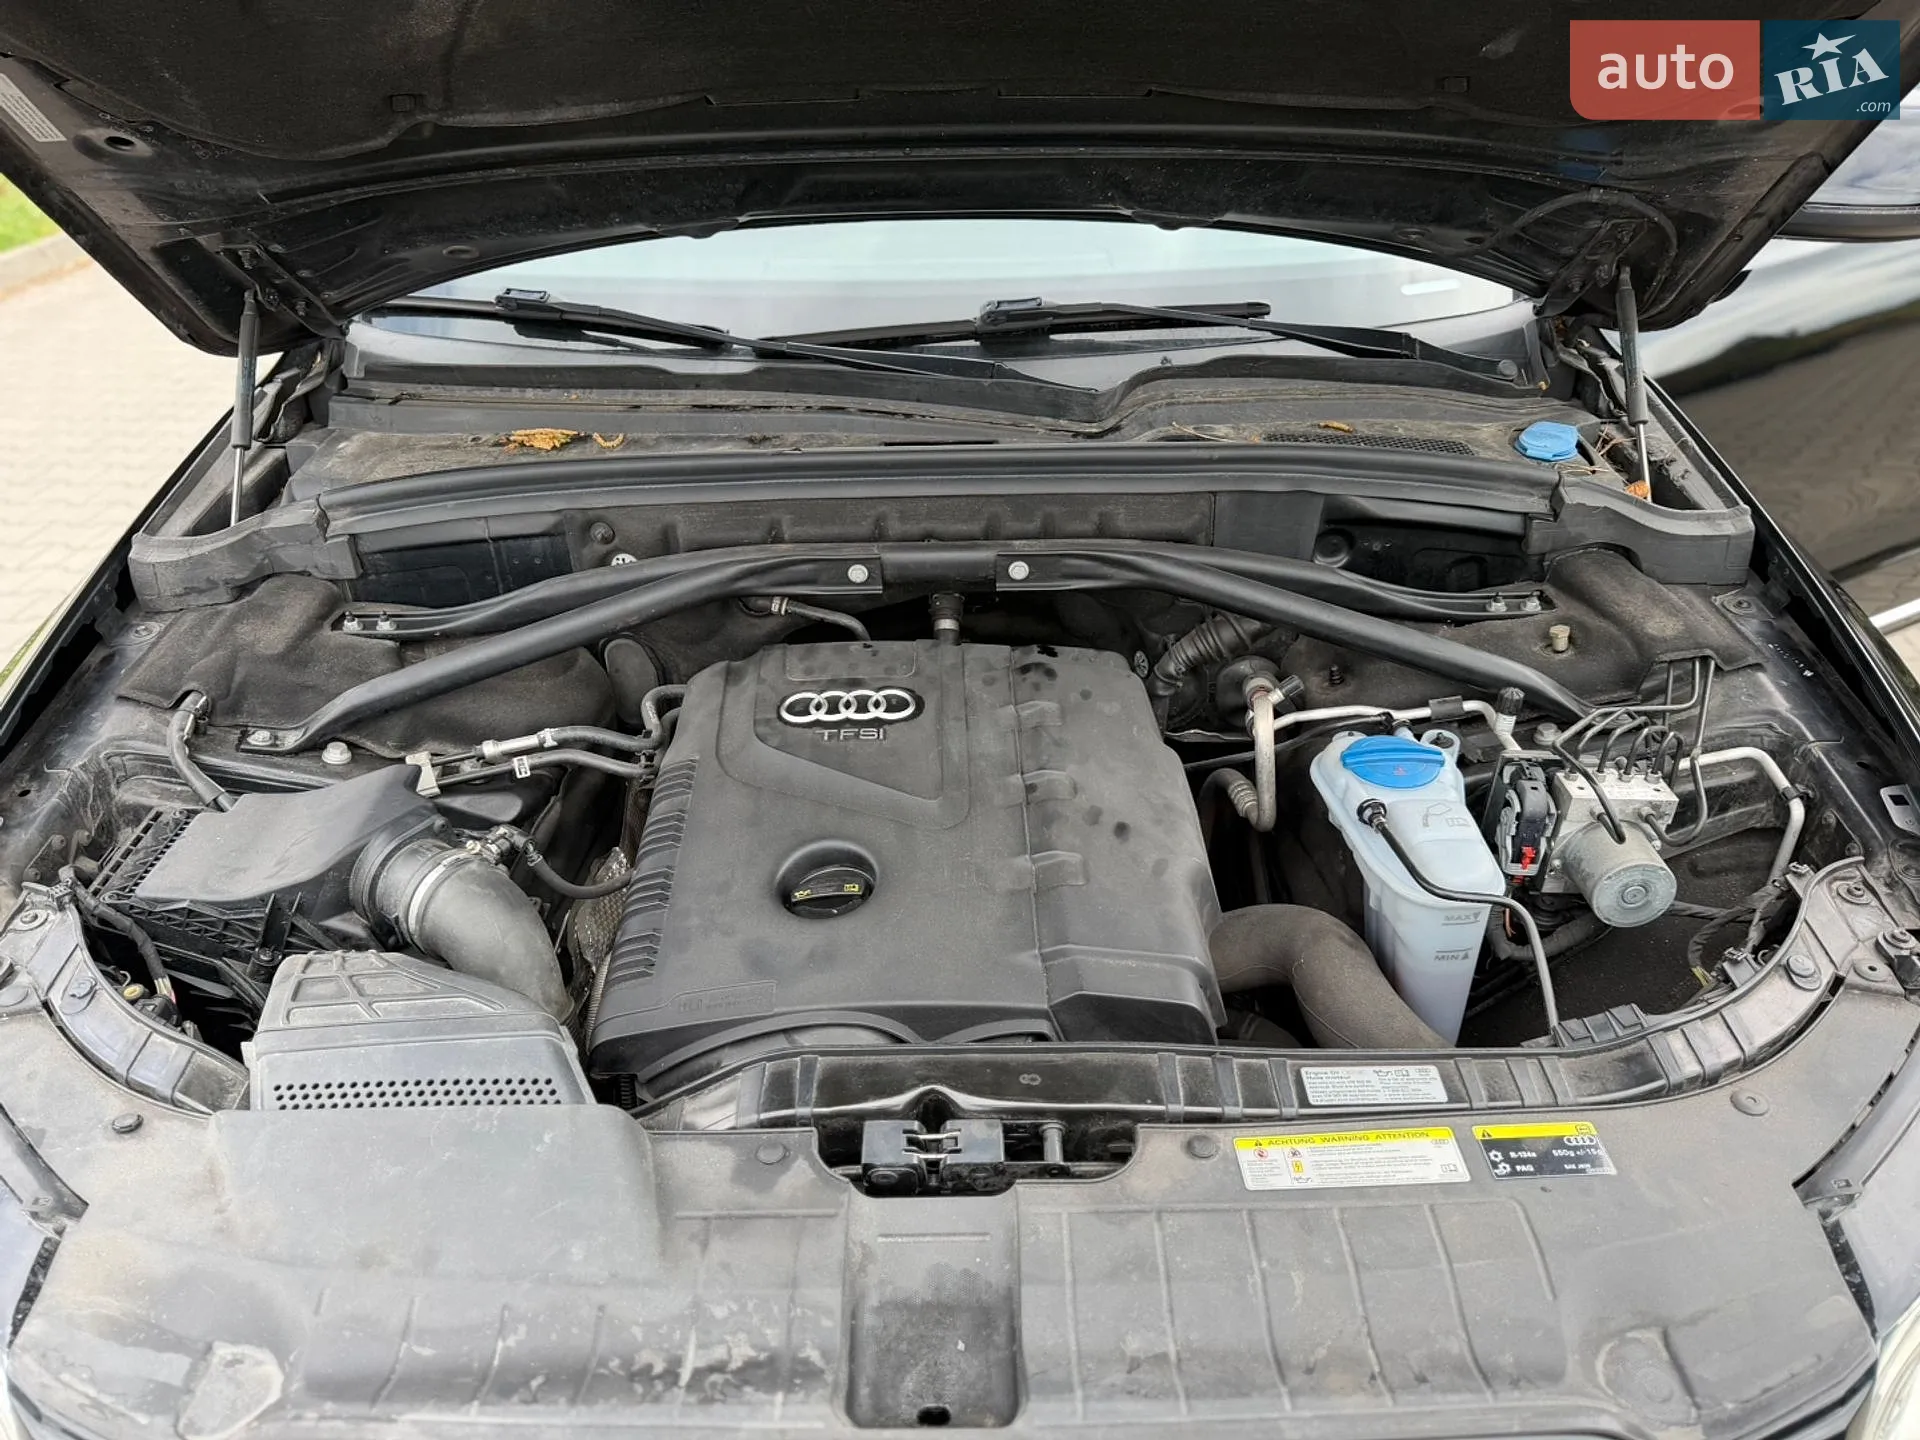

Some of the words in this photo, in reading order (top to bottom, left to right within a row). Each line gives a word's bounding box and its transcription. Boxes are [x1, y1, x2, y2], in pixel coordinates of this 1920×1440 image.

[815, 727, 884, 741] TFSI
[1267, 1137, 1316, 1146] ACHTUNG
[1319, 1134, 1370, 1143] WARNING
[1375, 1131, 1430, 1141] ATTENTION
[1515, 1164, 1535, 1172] PAG
